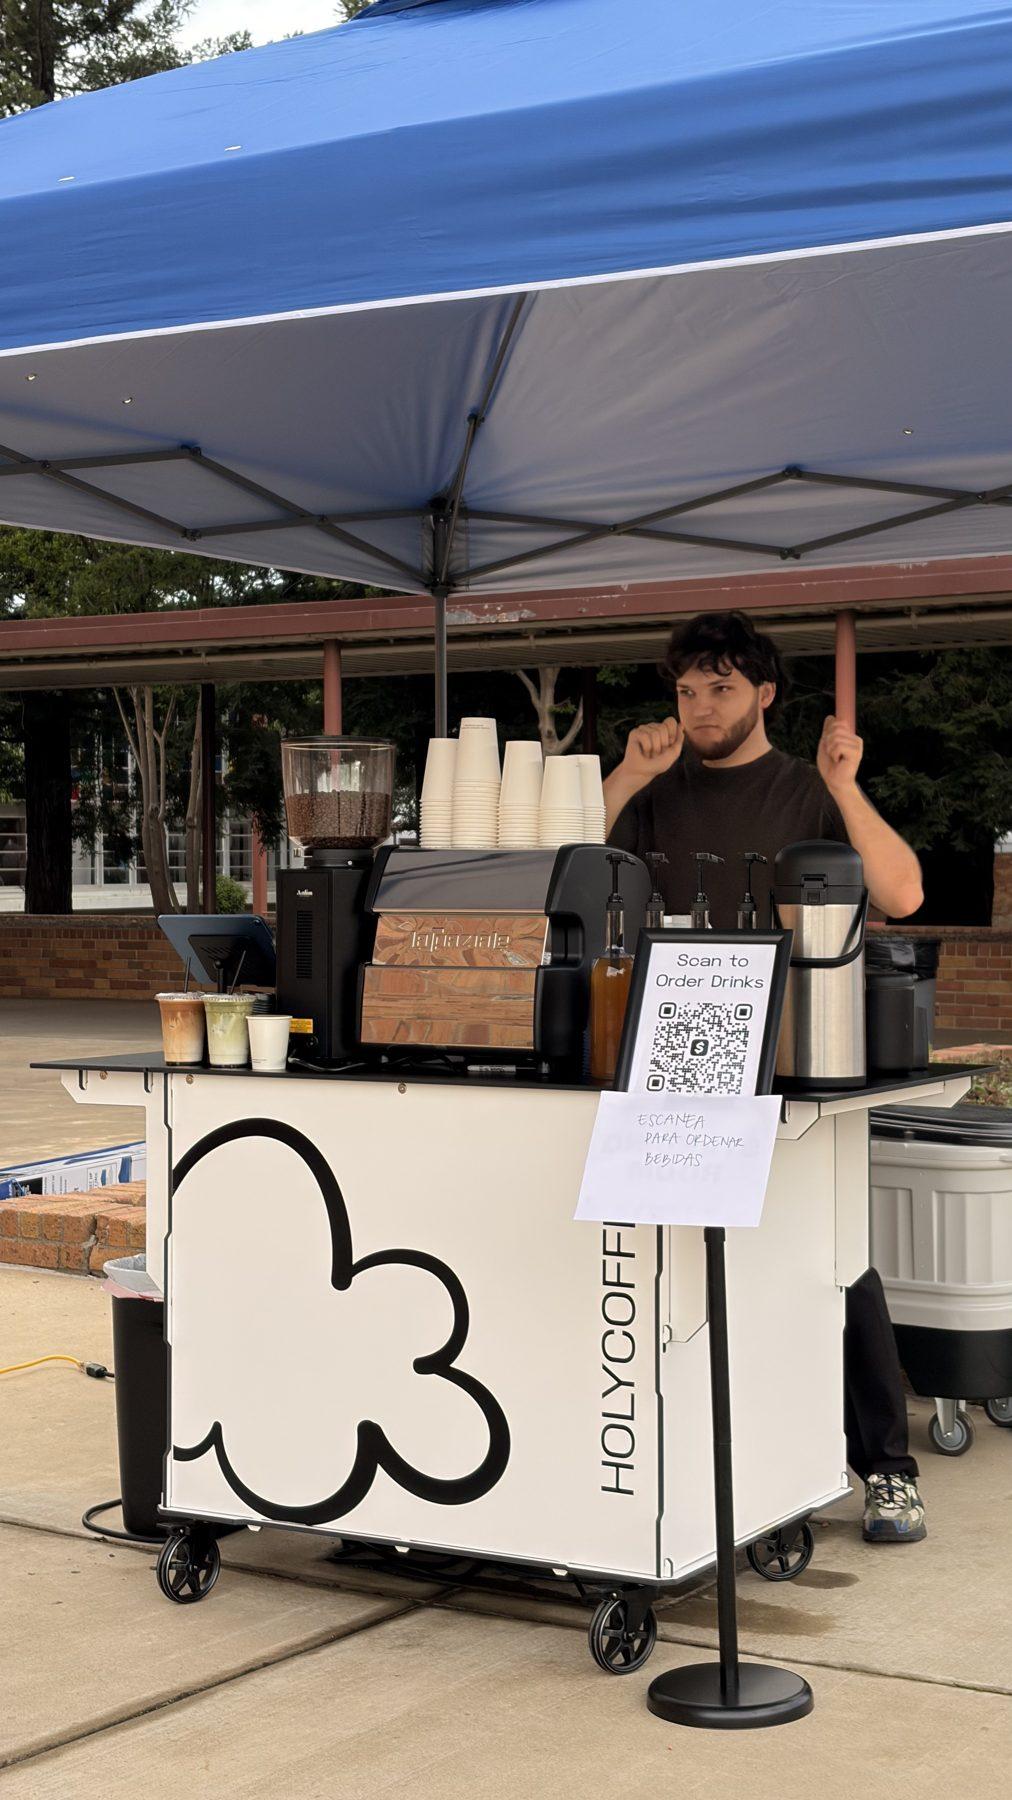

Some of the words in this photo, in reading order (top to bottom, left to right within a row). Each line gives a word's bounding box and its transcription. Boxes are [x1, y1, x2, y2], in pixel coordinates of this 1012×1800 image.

[676, 953, 722, 967] Scan
[729, 954, 749, 968] to
[655, 973, 705, 988] Order
[710, 974, 765, 989] Drinks
[637, 1112, 705, 1130] ESCANEA
[644, 1131, 680, 1145] PARA
[685, 1133, 745, 1149] ORDENAR
[644, 1152, 703, 1168] BEBIDAS
[600, 1221, 637, 1496] HOLYCOFF
